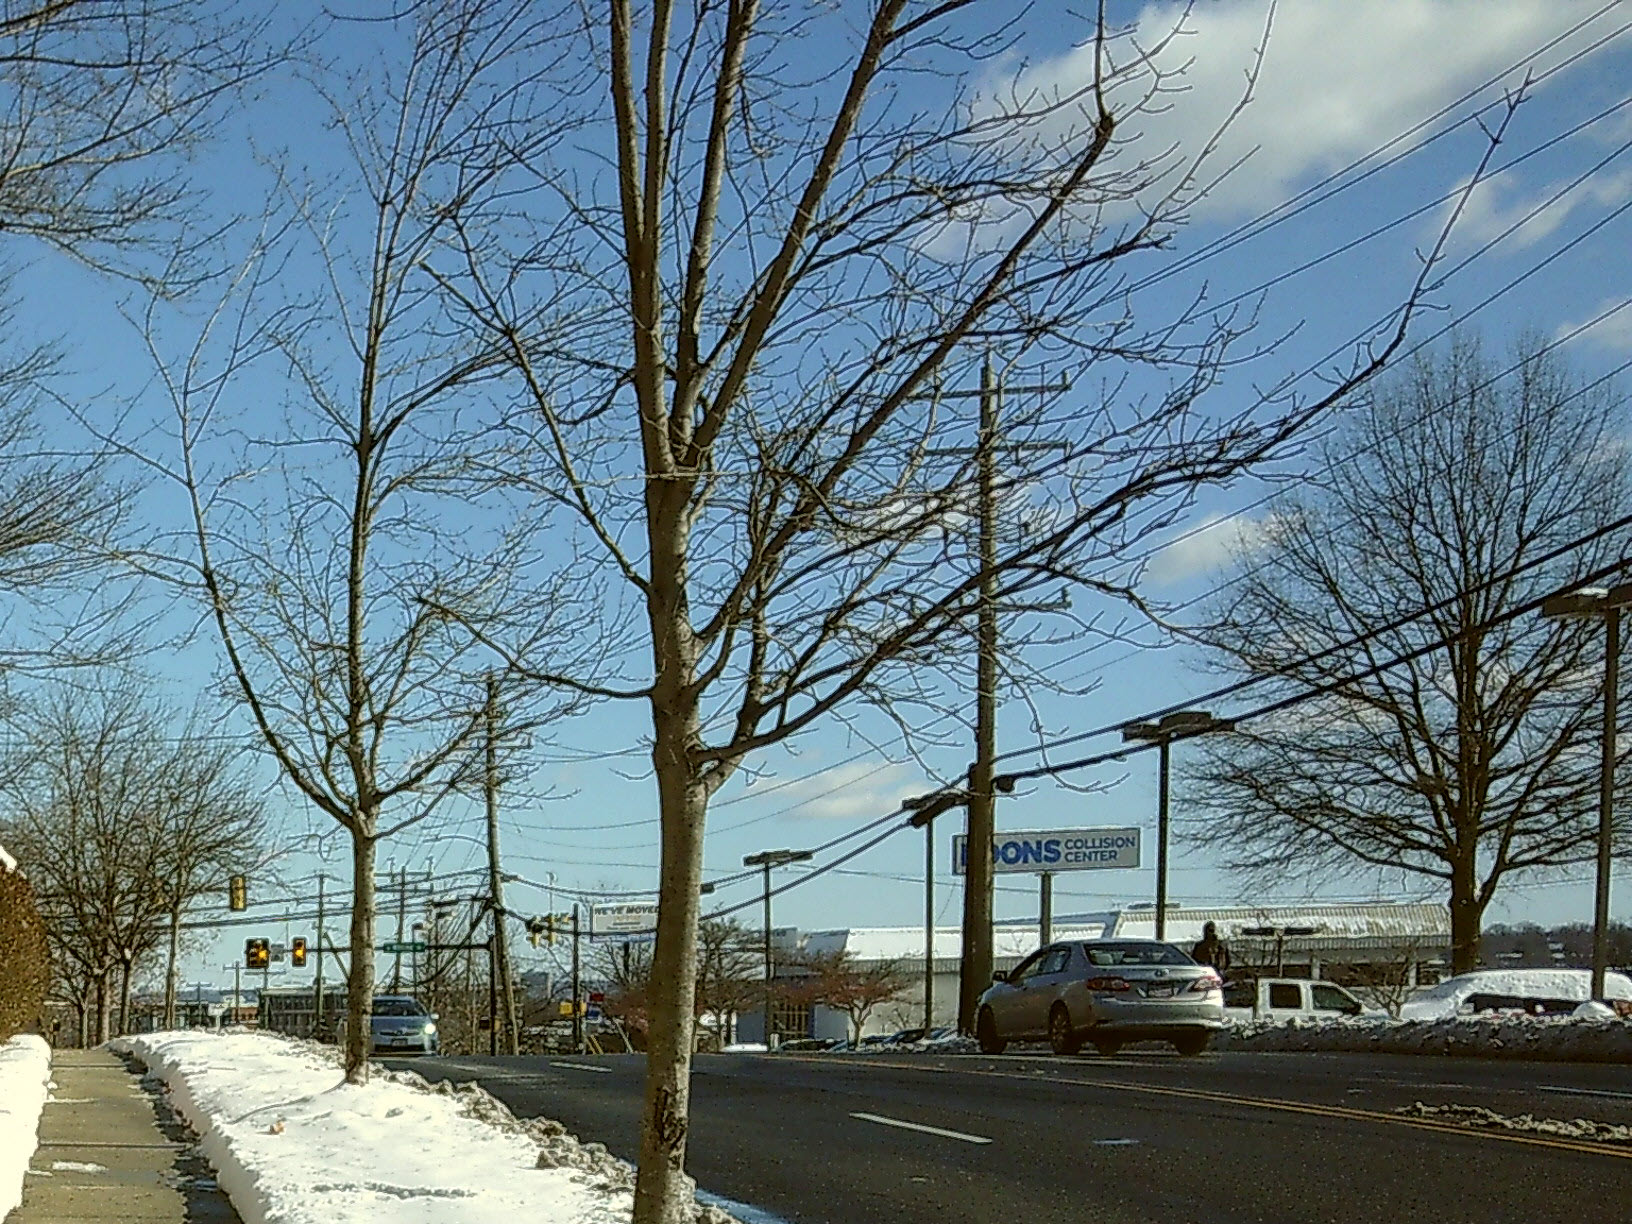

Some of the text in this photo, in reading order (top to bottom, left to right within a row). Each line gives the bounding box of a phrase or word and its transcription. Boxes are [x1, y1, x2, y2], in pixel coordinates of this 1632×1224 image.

[1064, 837, 1136, 850] COLLISION
[961, 840, 1061, 866] ONS
[1064, 850, 1118, 863] CENTER
